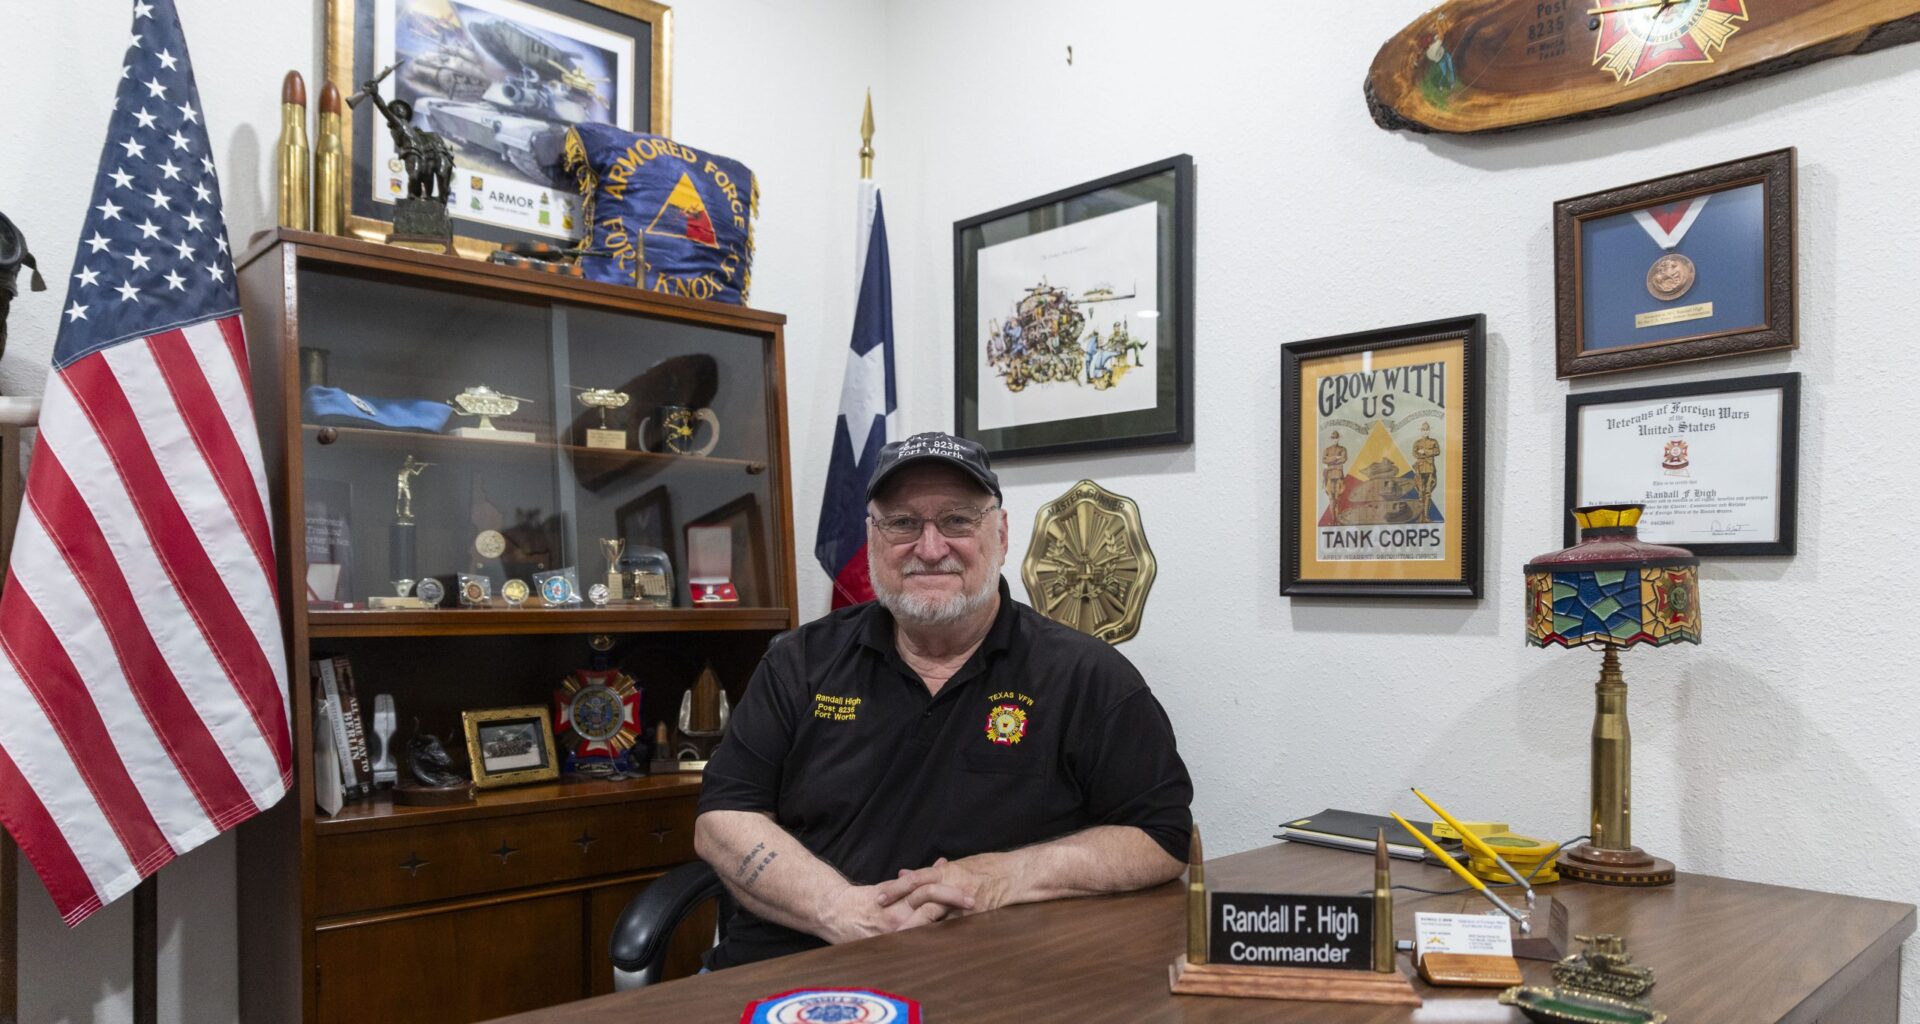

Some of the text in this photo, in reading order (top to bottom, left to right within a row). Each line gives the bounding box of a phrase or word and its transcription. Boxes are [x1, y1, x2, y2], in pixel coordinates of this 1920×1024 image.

[1537, 0, 1566, 18] Post
[1528, 16, 1565, 40] 8235
[604, 138, 745, 229] ARMORED FORCE
[489, 191, 534, 209] ARMOR
[653, 271, 723, 300] KNOX
[1318, 361, 1445, 417] GROW WITH
[1362, 394, 1395, 418] US
[1606, 401, 1750, 430] Veterans of Foreign Wars
[1638, 421, 1716, 436] United States
[898, 447, 964, 460] Fort Worth
[933, 440, 961, 450] 8235
[1048, 489, 1125, 515] MASTER GUNNER
[1645, 490, 1679, 499] Randall
[1694, 489, 1717, 499] High
[1322, 528, 1441, 548] TANK CORPS
[816, 693, 862, 706] Randall High
[818, 703, 836, 713] Post
[988, 691, 1034, 706] TEXAS VFW
[815, 710, 856, 721] Fort Worth
[343, 711, 360, 761] BERLIN
[350, 696, 370, 773] ALL THE WAY TO
[1222, 904, 1359, 941] Randall F. High
[1230, 941, 1350, 963] Commander
